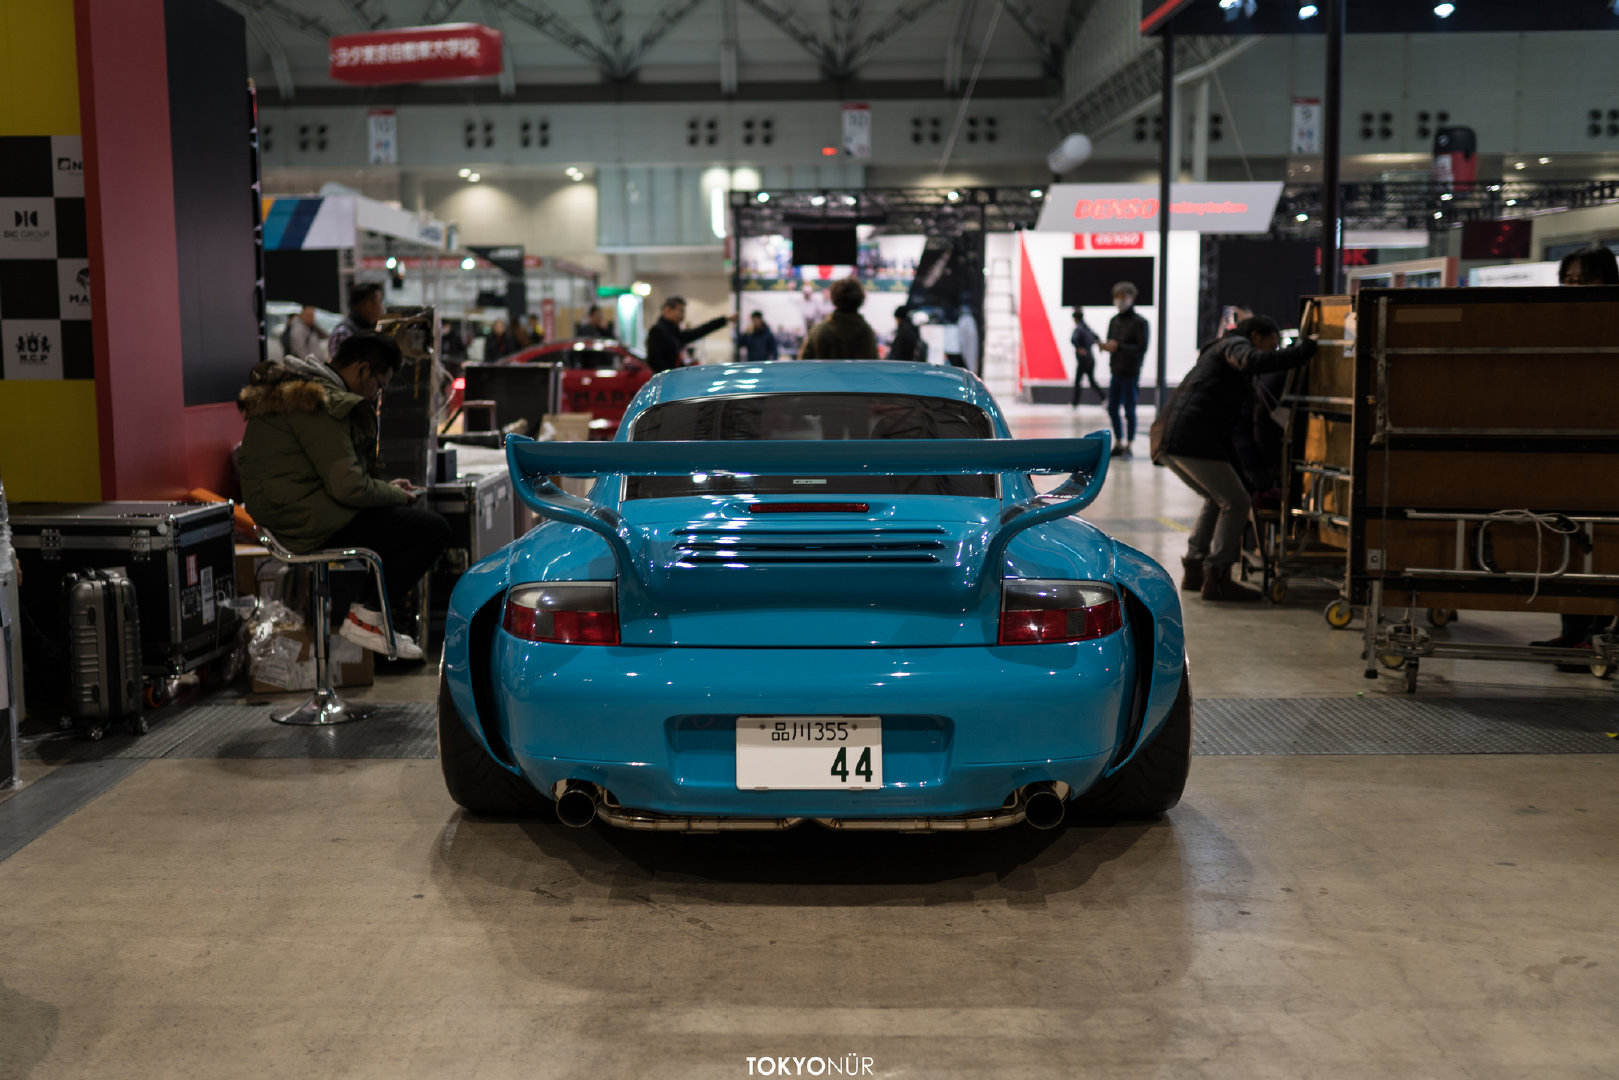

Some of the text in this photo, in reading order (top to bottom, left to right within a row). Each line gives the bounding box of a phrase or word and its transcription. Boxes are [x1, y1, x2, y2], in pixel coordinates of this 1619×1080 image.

[1073, 198, 1160, 220] DENSO
[20, 230, 50, 239] GROUP
[830, 746, 873, 782] 44
